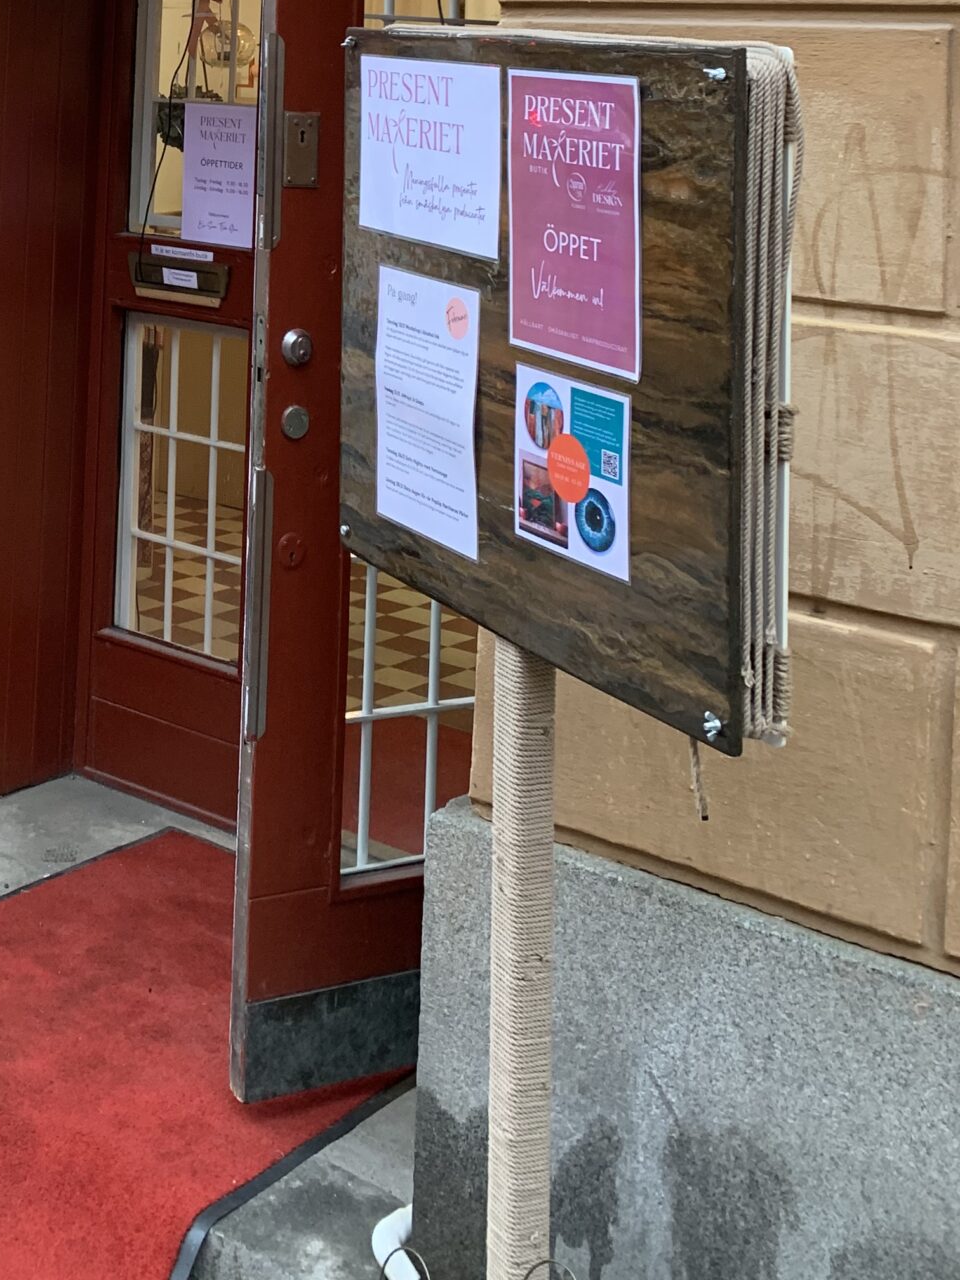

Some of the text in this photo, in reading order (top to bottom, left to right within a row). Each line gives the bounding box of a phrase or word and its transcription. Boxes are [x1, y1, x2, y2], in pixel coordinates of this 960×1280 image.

[367, 69, 454, 108] PRESENT
[200, 116, 242, 129] PRESENT
[524, 94, 615, 130] PRESENT
[200, 157, 244, 170] ÖPPETTIDER
[543, 223, 602, 262] ÖPPET
[531, 260, 589, 300] Välkommen
